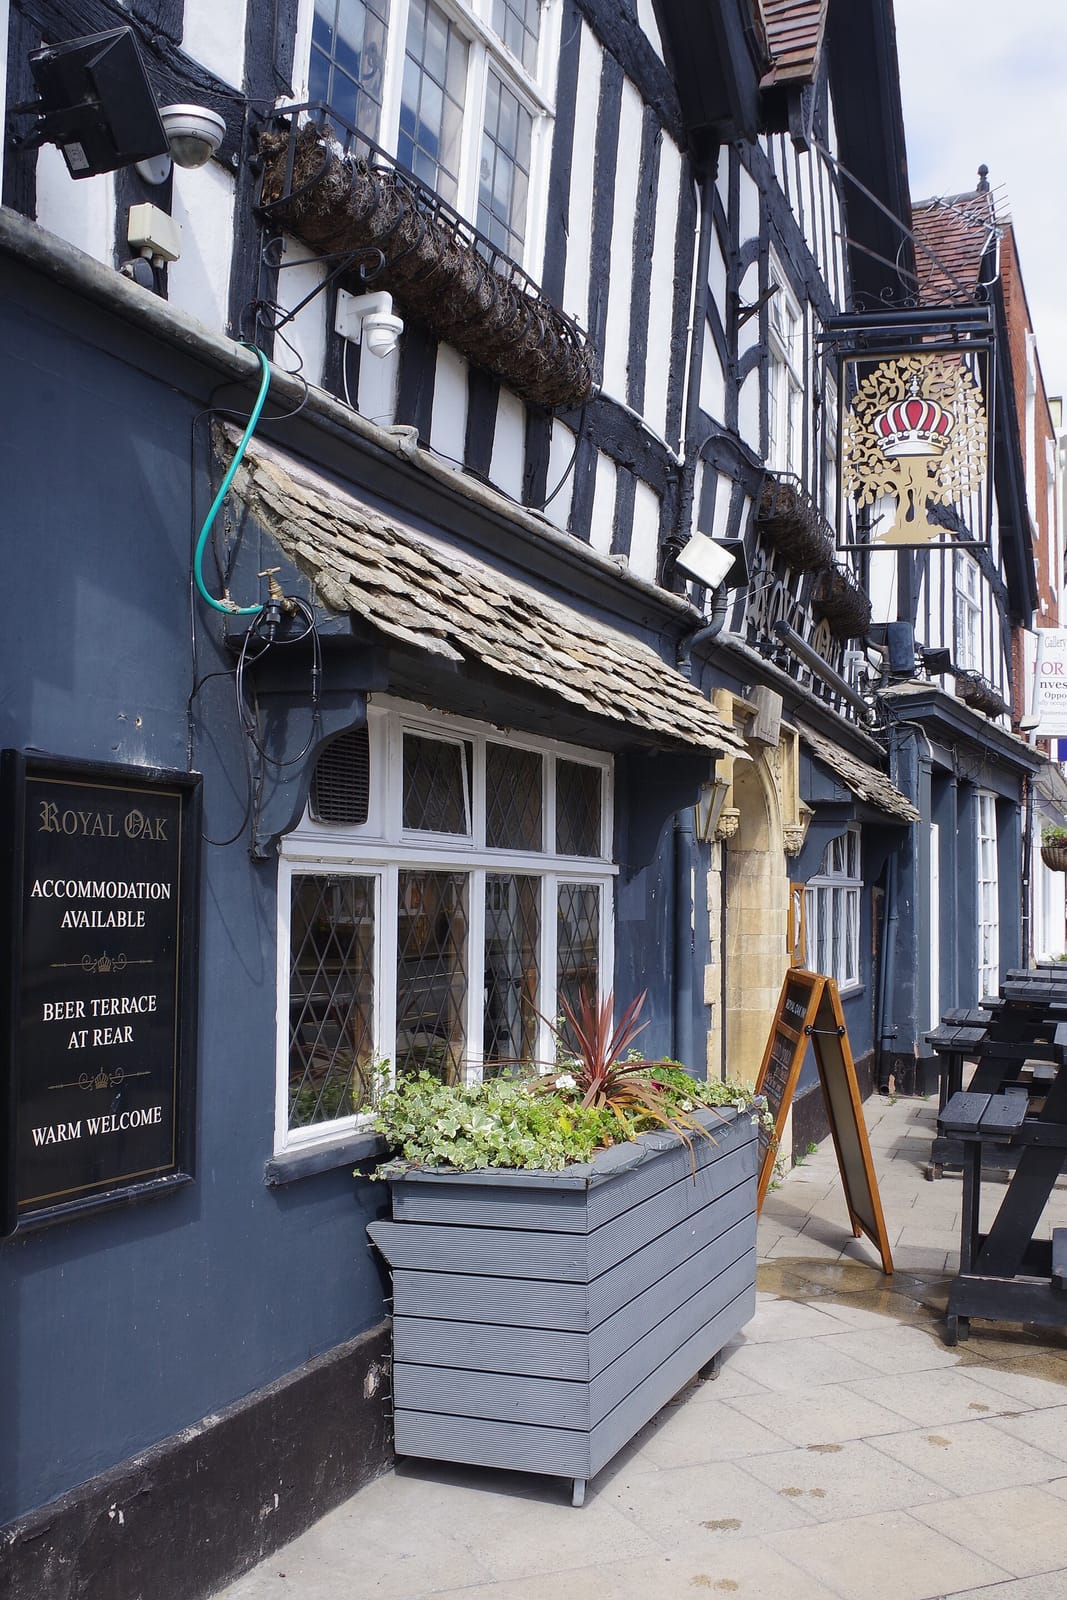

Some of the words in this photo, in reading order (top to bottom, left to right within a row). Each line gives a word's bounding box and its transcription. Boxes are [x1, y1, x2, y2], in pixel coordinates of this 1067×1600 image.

[1040, 681, 1067, 689] nves
[38, 800, 120, 837] ROYAL
[124, 809, 168, 840] OAK
[30, 879, 171, 899] ACCOMMODATION
[61, 910, 146, 928] AVAILABLE
[43, 1000, 86, 1021] BEER
[91, 995, 157, 1017] TERRACE
[67, 1030, 88, 1049] AT
[93, 1025, 134, 1046] REAR
[32, 1120, 82, 1147] WARM
[87, 1106, 162, 1136] WELCOME
